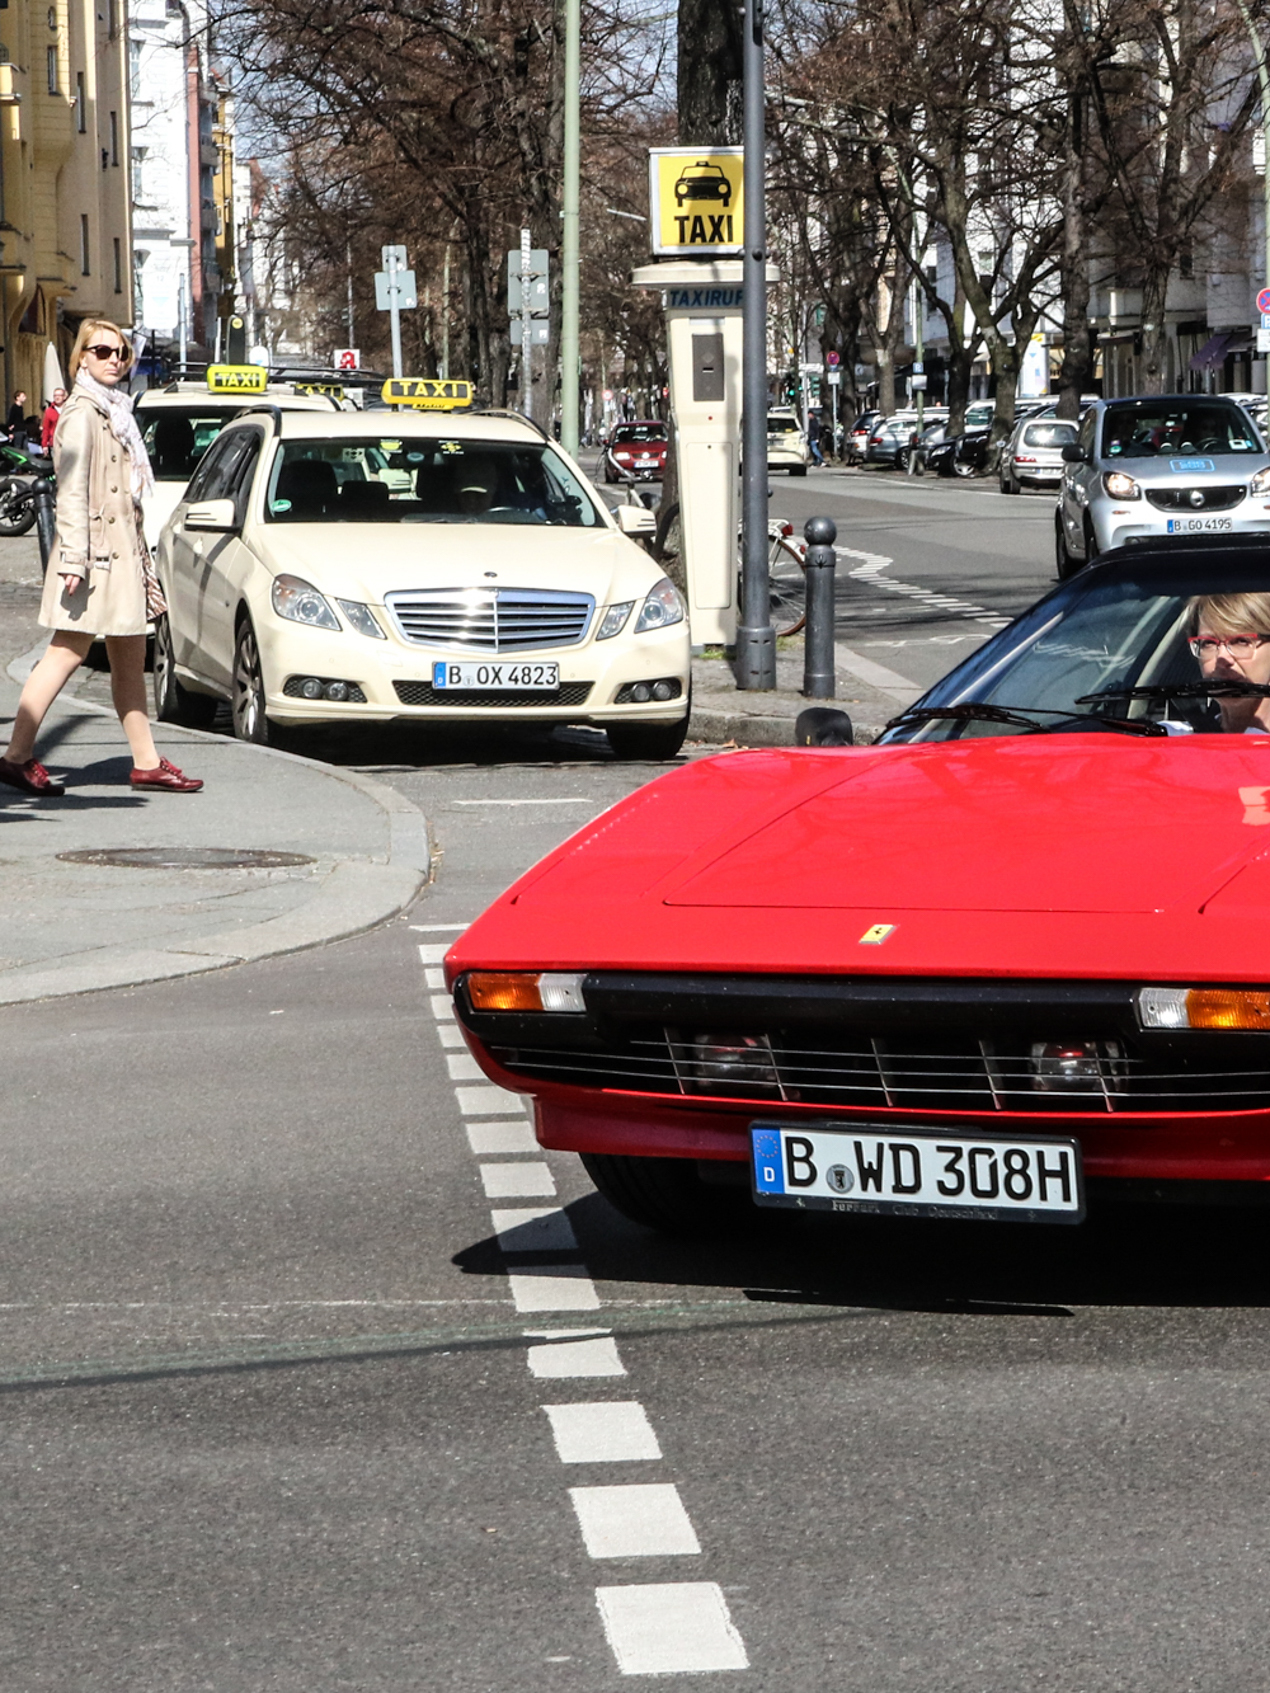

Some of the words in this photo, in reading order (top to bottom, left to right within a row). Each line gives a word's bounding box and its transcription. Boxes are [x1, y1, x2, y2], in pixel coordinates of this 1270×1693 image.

[674, 215, 733, 243] TAXI
[670, 288, 743, 306] TAXIRUF
[218, 373, 258, 387] TAXI
[400, 381, 457, 397] TAXI
[1175, 522, 1181, 530] B
[1205, 518, 1231, 529] 4195
[449, 666, 461, 684] B
[477, 666, 502, 685] OX
[508, 666, 557, 685] 4823
[764, 1167, 775, 1182] D
[785, 1137, 817, 1188] B
[854, 1141, 922, 1195] WD
[936, 1146, 1070, 1202] 308H
